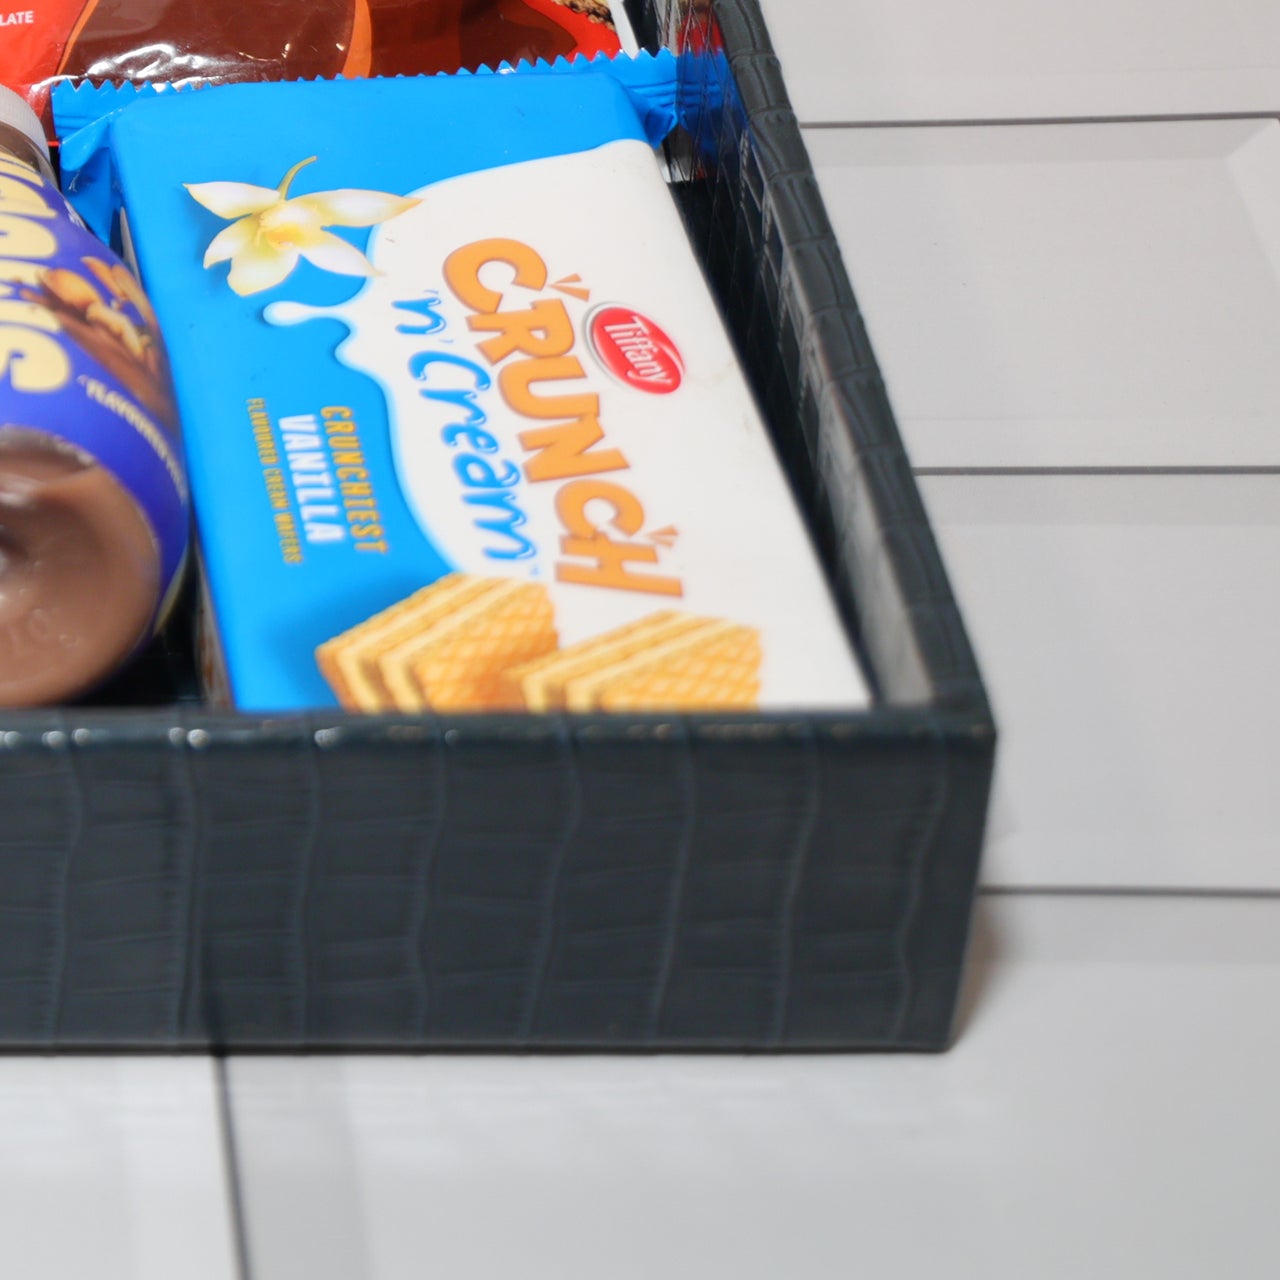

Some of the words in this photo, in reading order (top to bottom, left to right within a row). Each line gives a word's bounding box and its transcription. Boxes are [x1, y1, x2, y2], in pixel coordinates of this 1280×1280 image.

[604, 316, 673, 385] Tiffany
[246, 398, 279, 464] FLAVOURED
[408, 351, 537, 560] Cream
[443, 238, 683, 598] CRUNCH
[263, 469, 289, 509] CREAM
[279, 414, 345, 542] VANILLA
[321, 406, 388, 553] CRUNCHIEST
[274, 511, 303, 563] WAFERS
